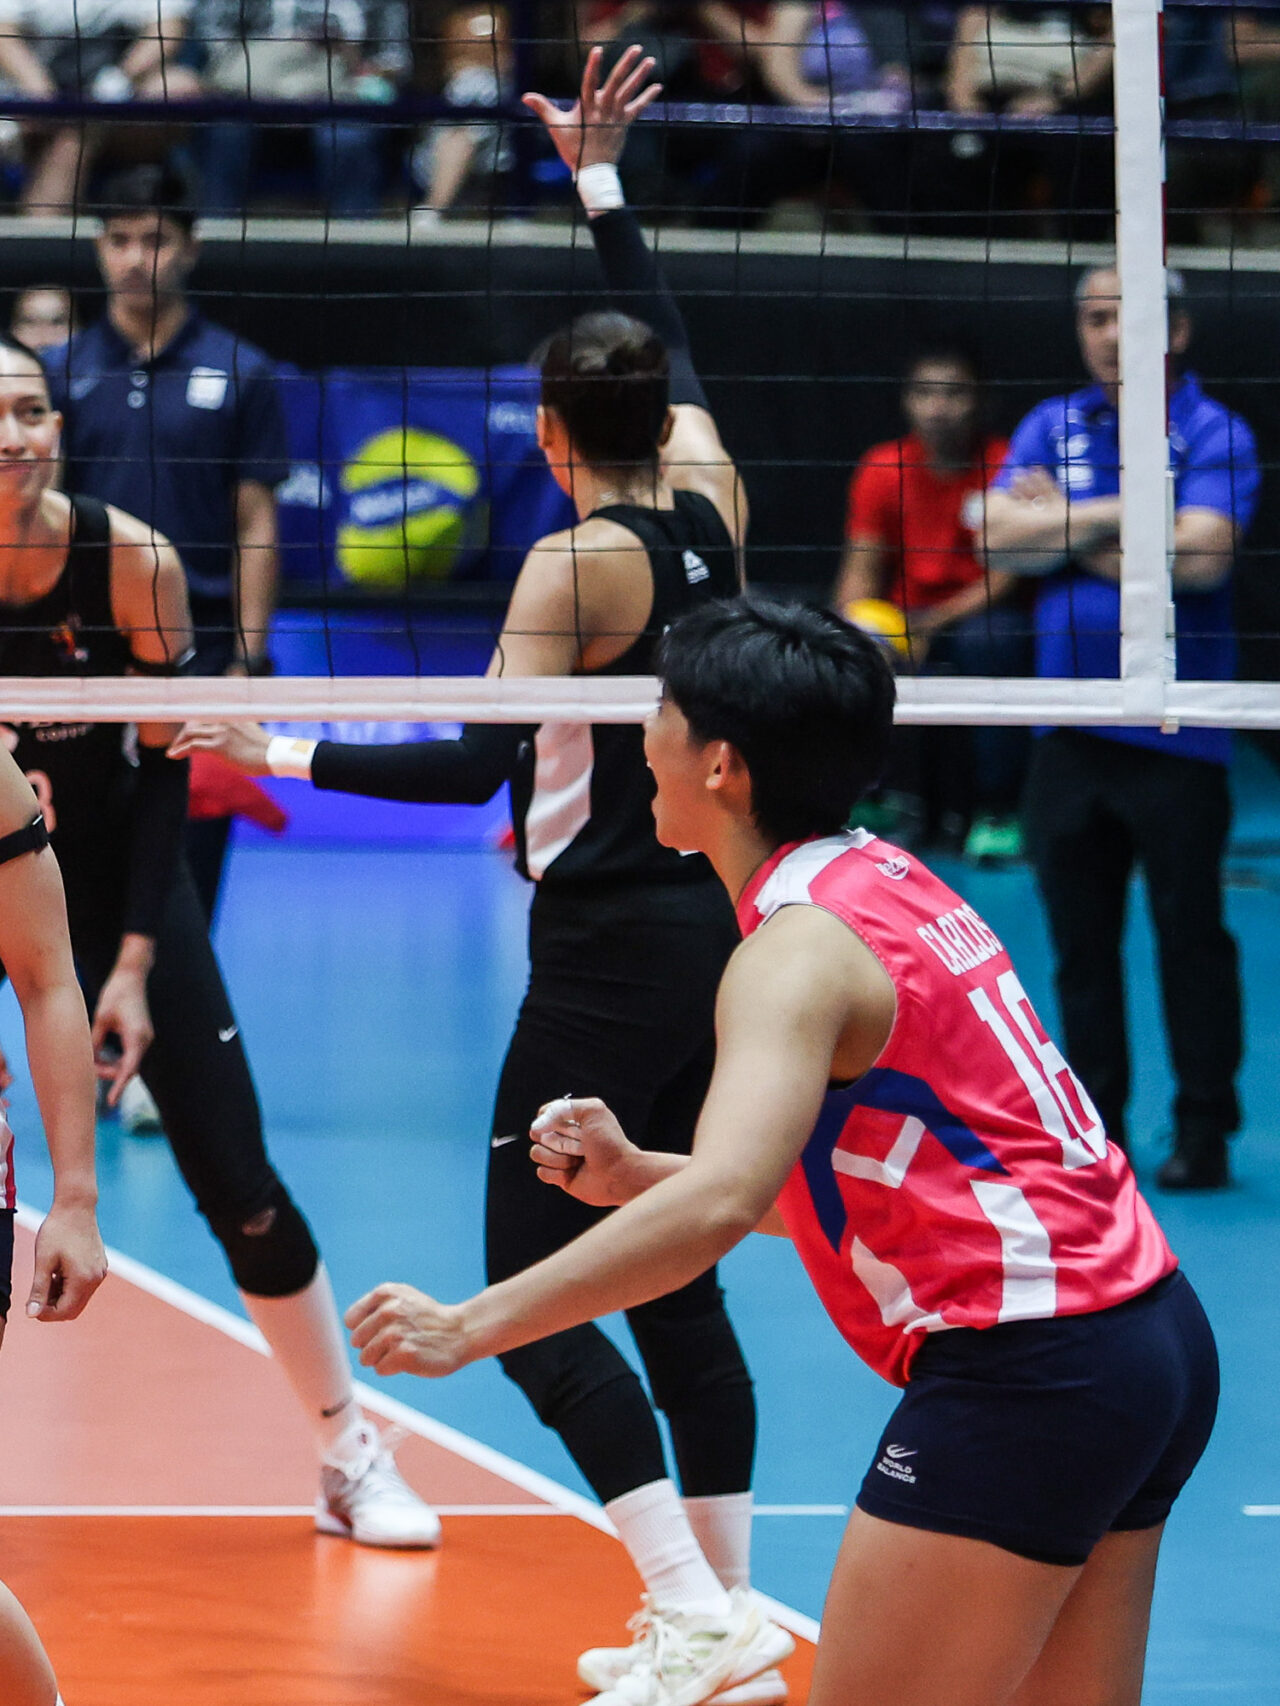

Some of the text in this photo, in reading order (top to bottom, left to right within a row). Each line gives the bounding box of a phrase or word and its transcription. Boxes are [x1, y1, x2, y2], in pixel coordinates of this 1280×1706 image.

[916, 903, 1004, 976] CARLOS
[876, 1462, 916, 1484] BALANCE
[882, 1457, 912, 1474] WORLD
